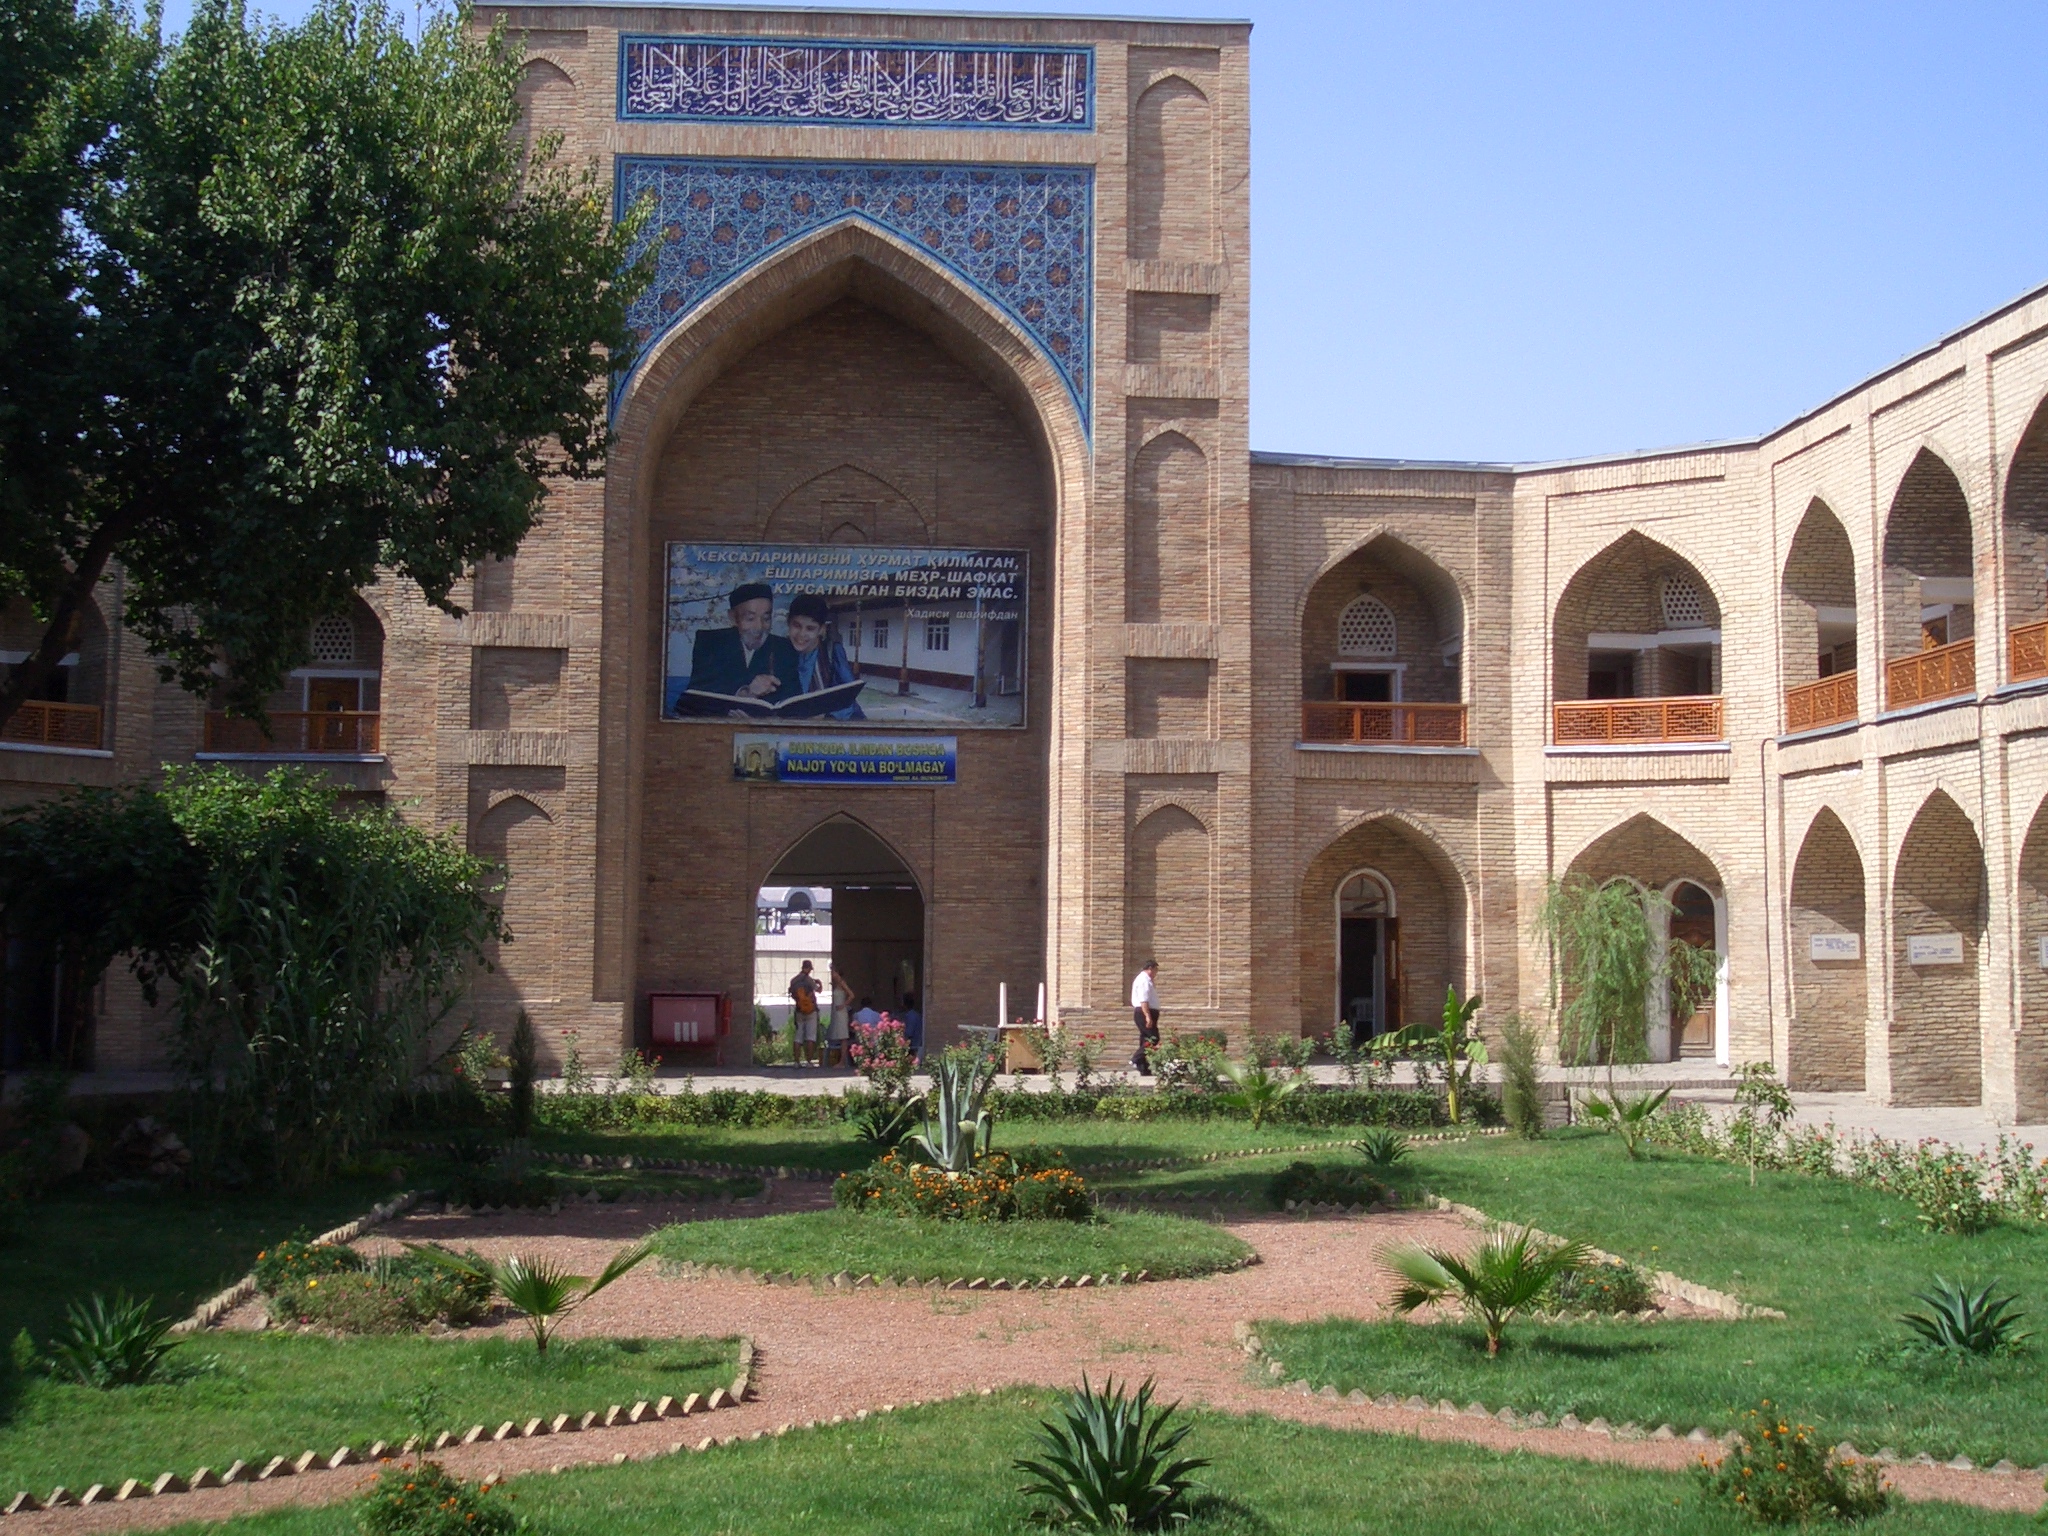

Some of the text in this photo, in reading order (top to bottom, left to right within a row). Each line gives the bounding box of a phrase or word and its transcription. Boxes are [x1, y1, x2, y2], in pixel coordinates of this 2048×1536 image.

[697, 550, 1019, 570] КЕКСАЛАРИМИЗНИ ҲУРМАТ ҚИЛМАГАН,
[765, 565, 1018, 586] ЁШЛАРИМИЗГА МЕҲР-ШАФҚАТ
[773, 580, 1018, 600] КЎРСАТМАГАН БИЗДАН ЭМАС.
[787, 759, 827, 772] NAJOT
[860, 761, 876, 773] VA
